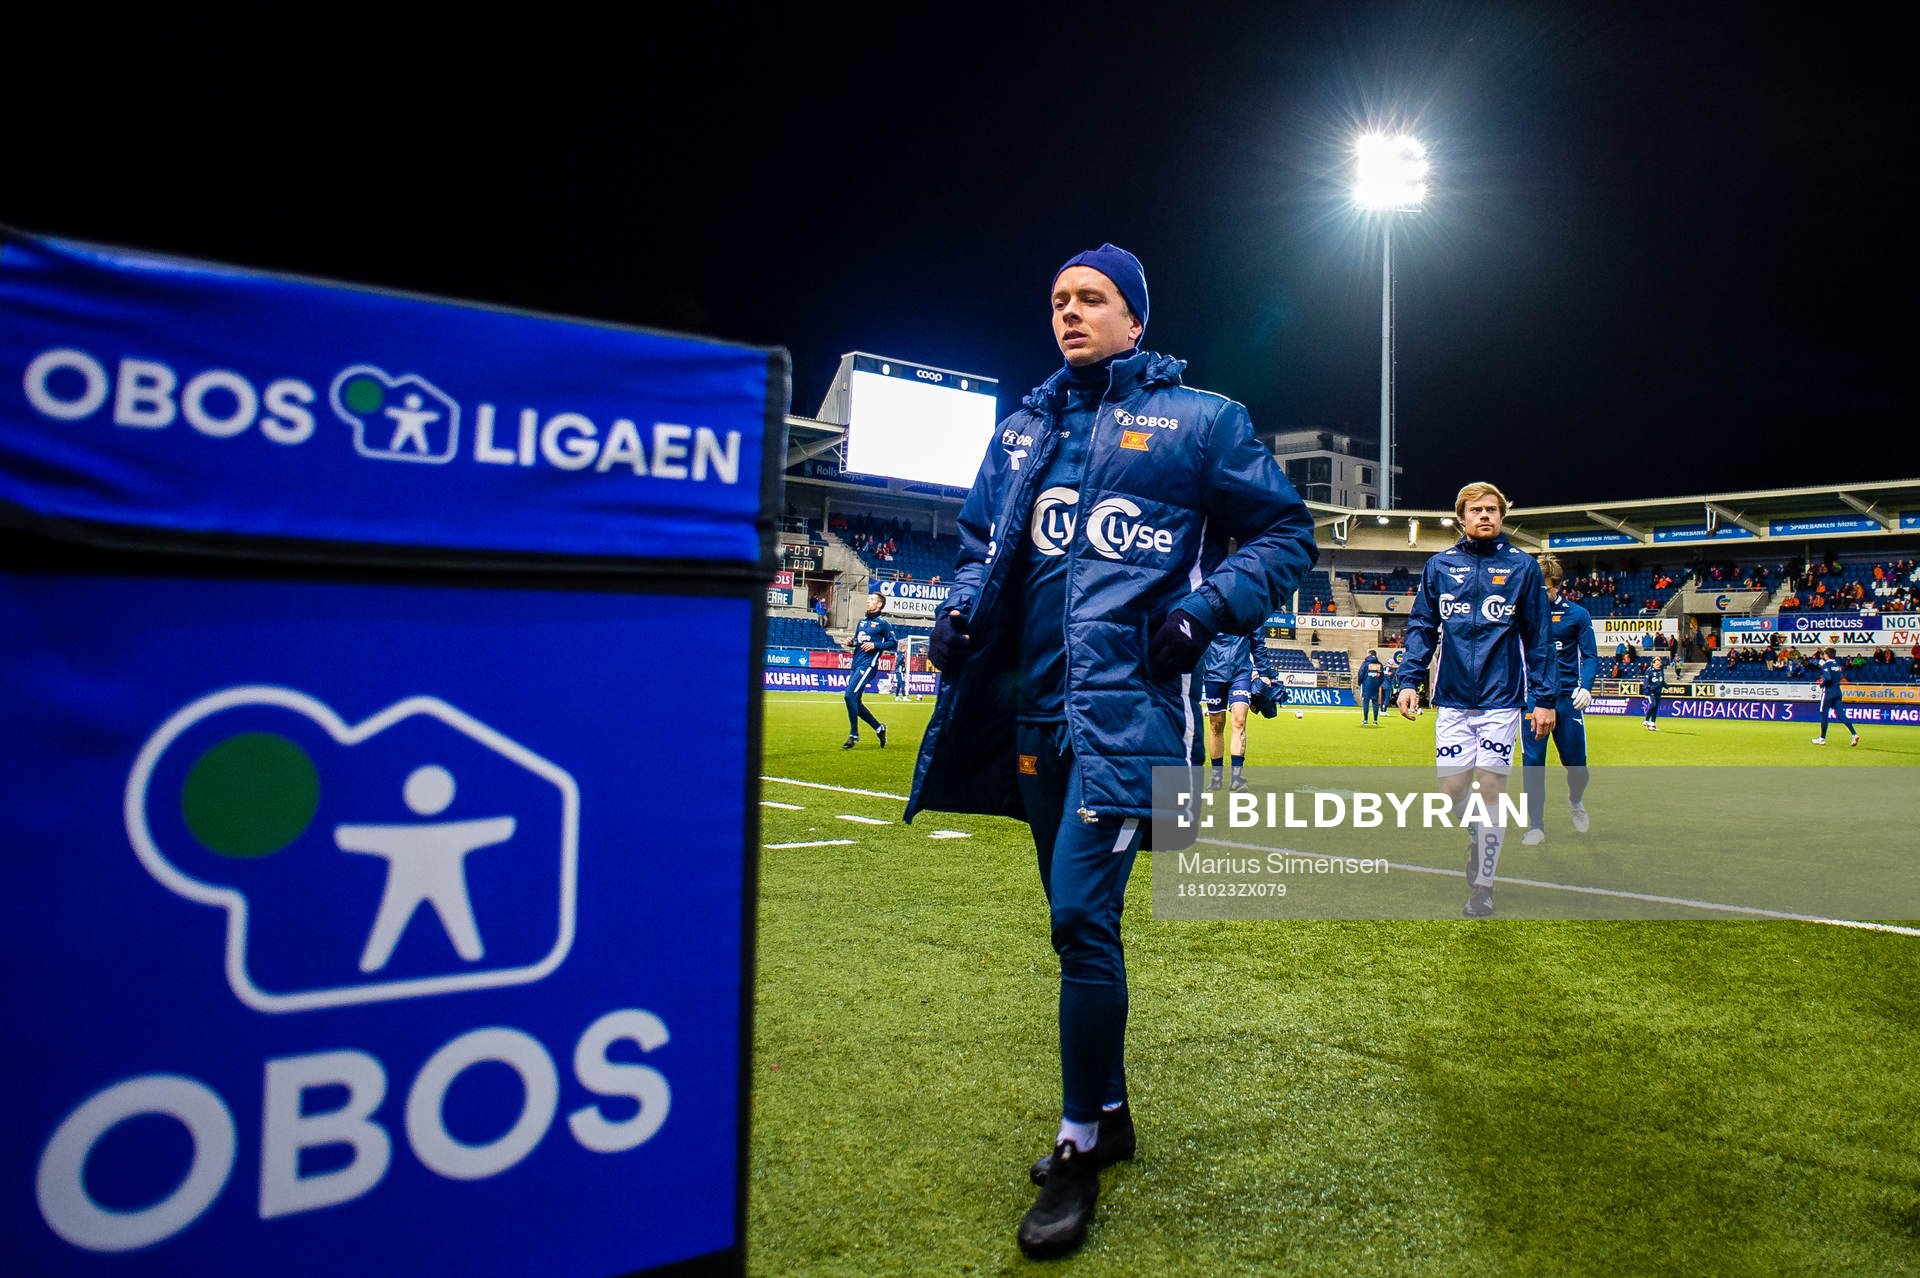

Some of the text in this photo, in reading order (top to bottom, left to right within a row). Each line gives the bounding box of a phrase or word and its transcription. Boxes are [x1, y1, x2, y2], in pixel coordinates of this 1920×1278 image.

[916, 369, 943, 383] coop
[24, 349, 742, 485] OBOS LIGAEN
[1136, 415, 1178, 430] OBOS
[893, 600, 937, 613] MØRENO
[1311, 618, 1349, 628] Bunker
[1811, 618, 1863, 629] nettbuss
[1886, 617, 1920, 628] NOG
[1791, 632, 1821, 644] MAX
[1843, 632, 1875, 643] MAX
[1333, 690, 1341, 705] 3
[1733, 687, 1780, 696] BRAGES
[1672, 700, 1793, 720] SMIBAKKEN 3
[1482, 833, 1500, 878] coop
[36, 1008, 672, 1254] OBOS
